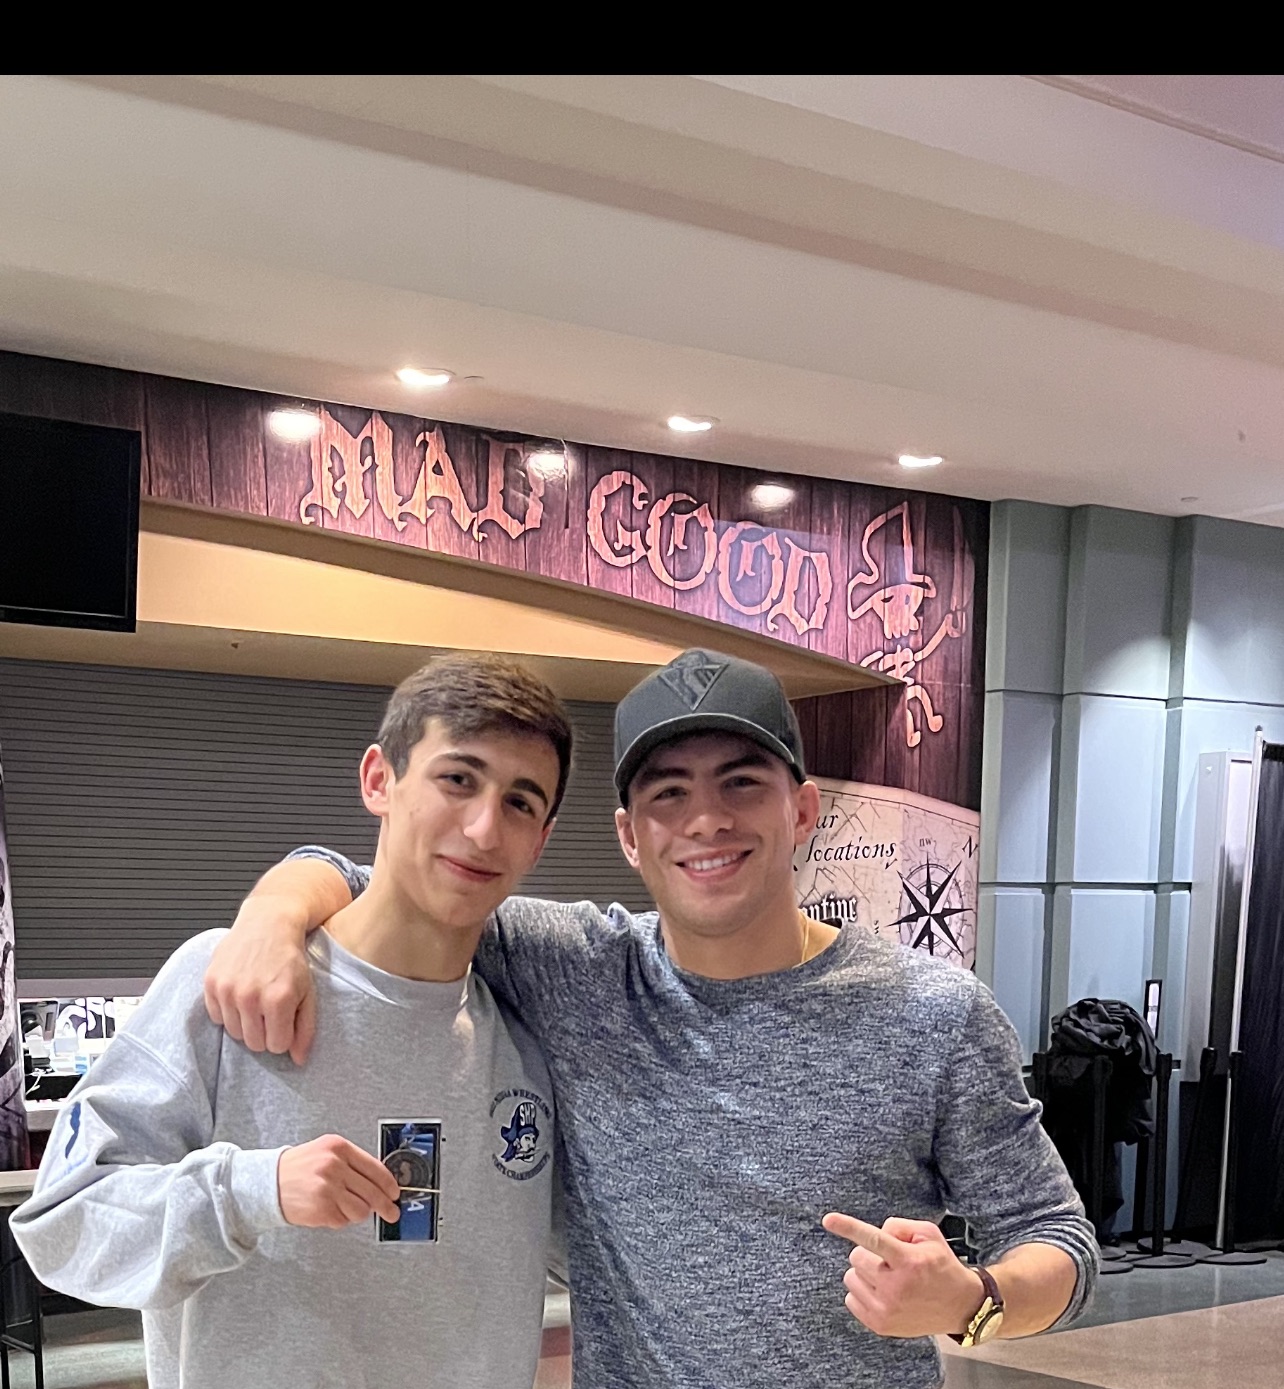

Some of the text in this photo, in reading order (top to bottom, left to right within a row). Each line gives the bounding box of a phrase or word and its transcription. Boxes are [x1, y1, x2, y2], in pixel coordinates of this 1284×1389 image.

[299, 404, 832, 636] MAD GOOD
[815, 814, 838, 829] ur
[805, 835, 896, 862] locations
[961, 835, 978, 858] N
